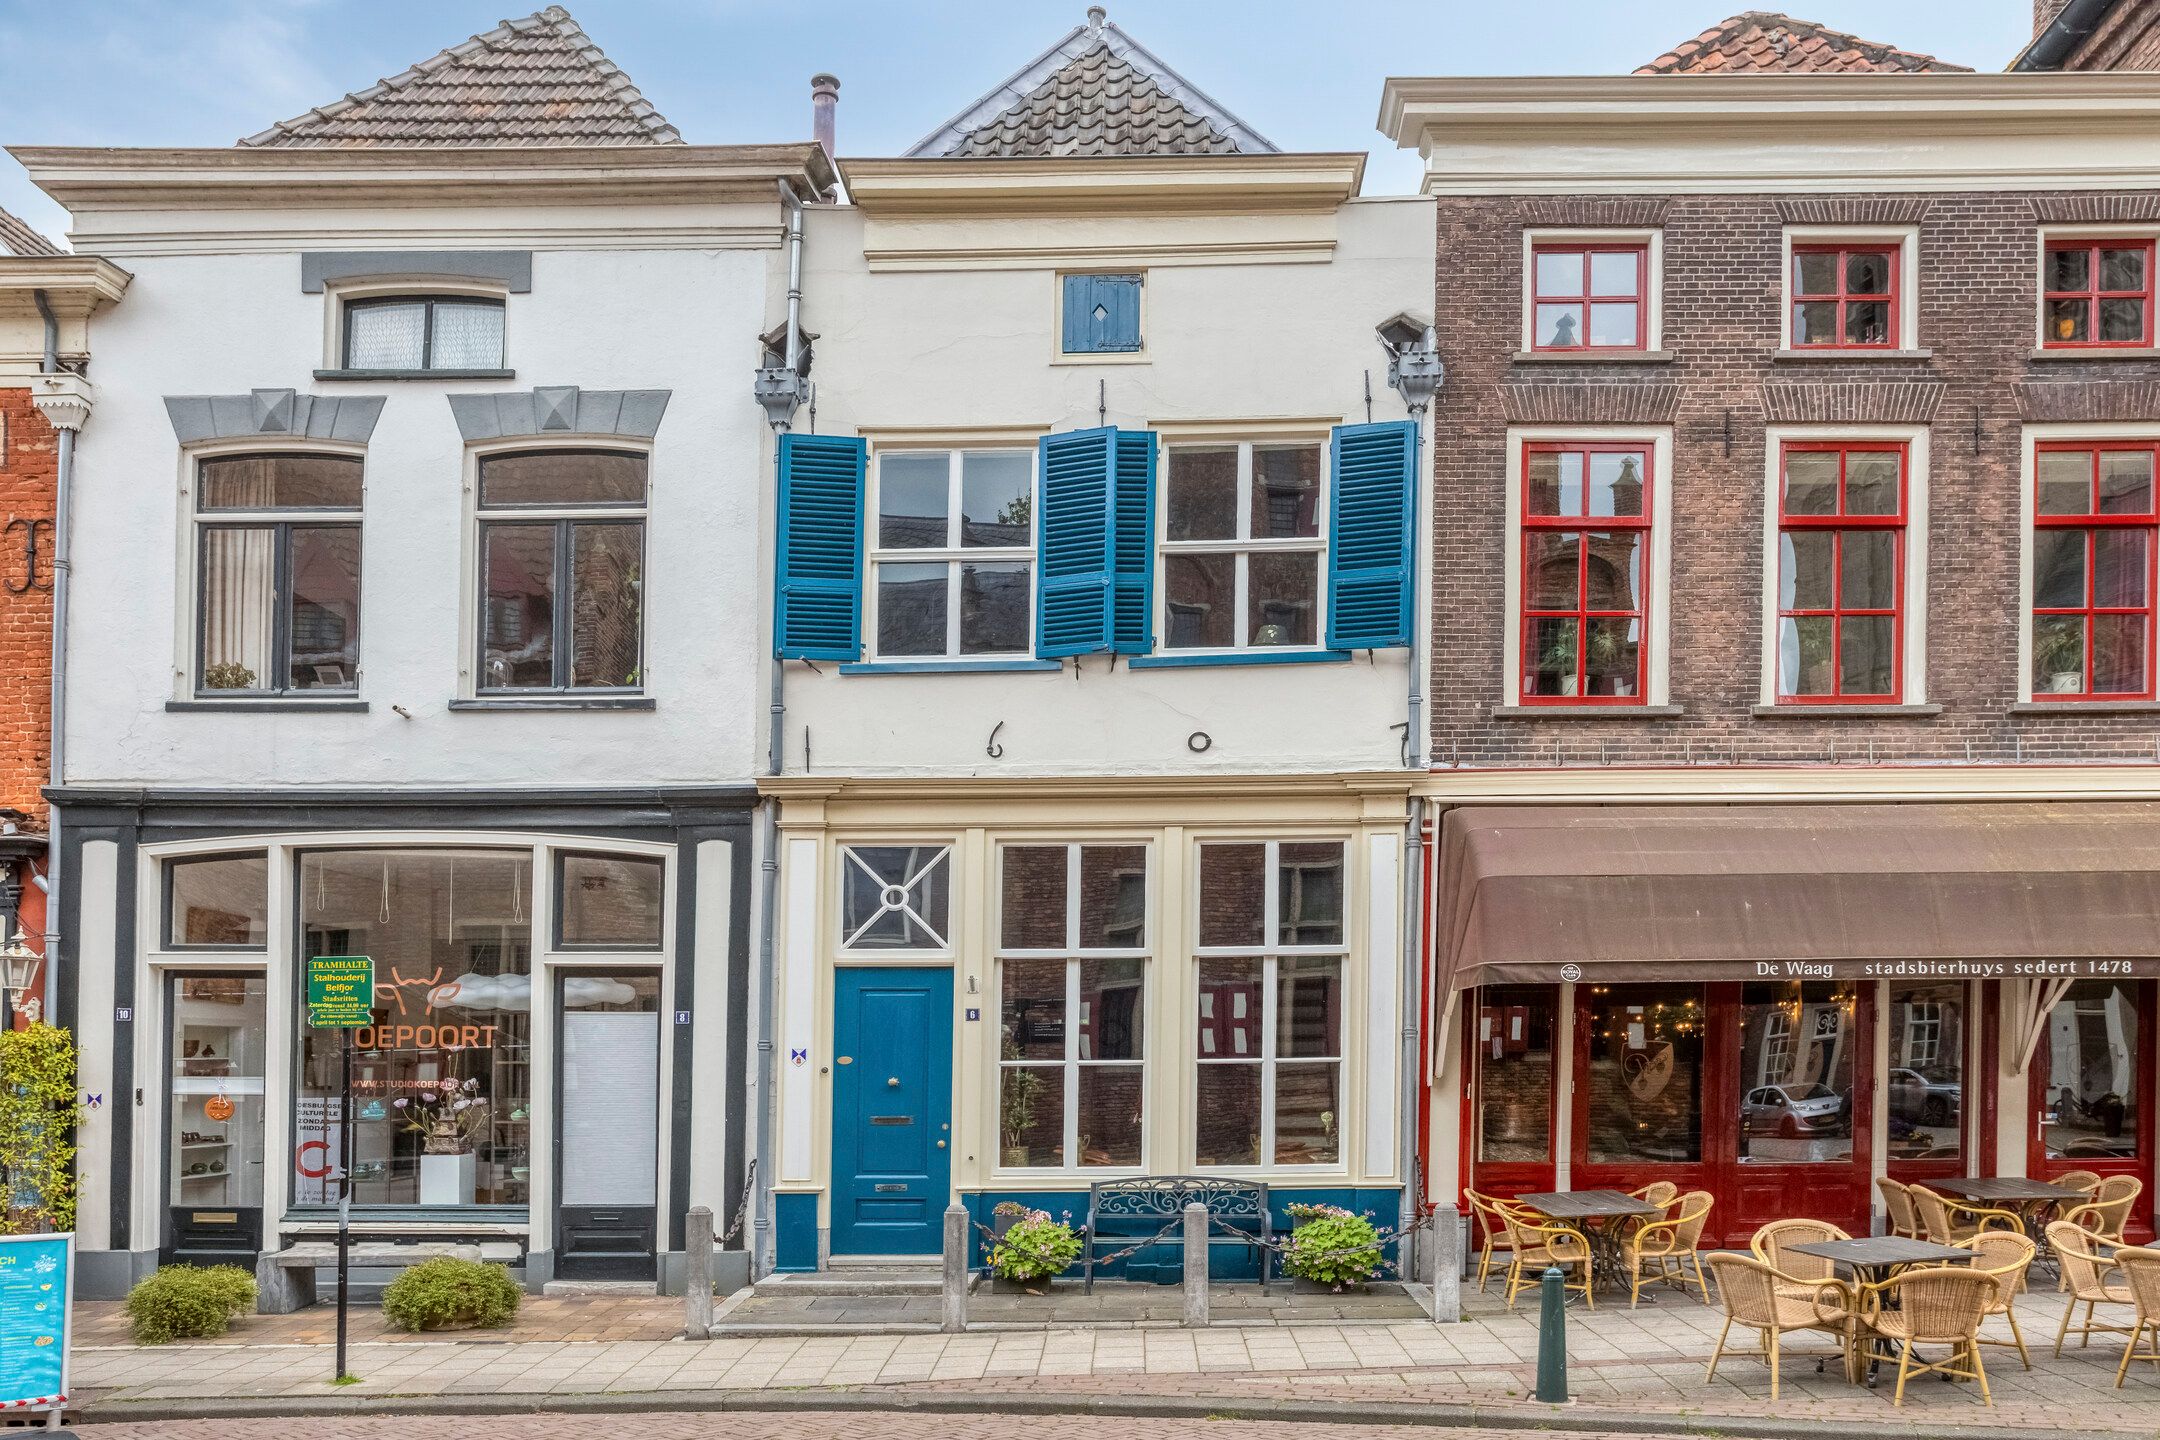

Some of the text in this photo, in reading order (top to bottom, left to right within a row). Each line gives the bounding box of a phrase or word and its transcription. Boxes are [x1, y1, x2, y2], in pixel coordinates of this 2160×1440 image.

[312, 960, 369, 969] TRAMHALTE
[1785, 961, 1834, 979] Waag
[1865, 960, 2004, 976] stadsbierhuys
[2014, 960, 2077, 974] sedert
[2088, 960, 2132, 974] 1478
[313, 973, 366, 983] Stalhouderij
[119, 1010, 128, 1019] 10
[679, 1013, 685, 1022] 8
[970, 1010, 975, 1019] 6
[353, 1026, 499, 1049] OEPOORT
